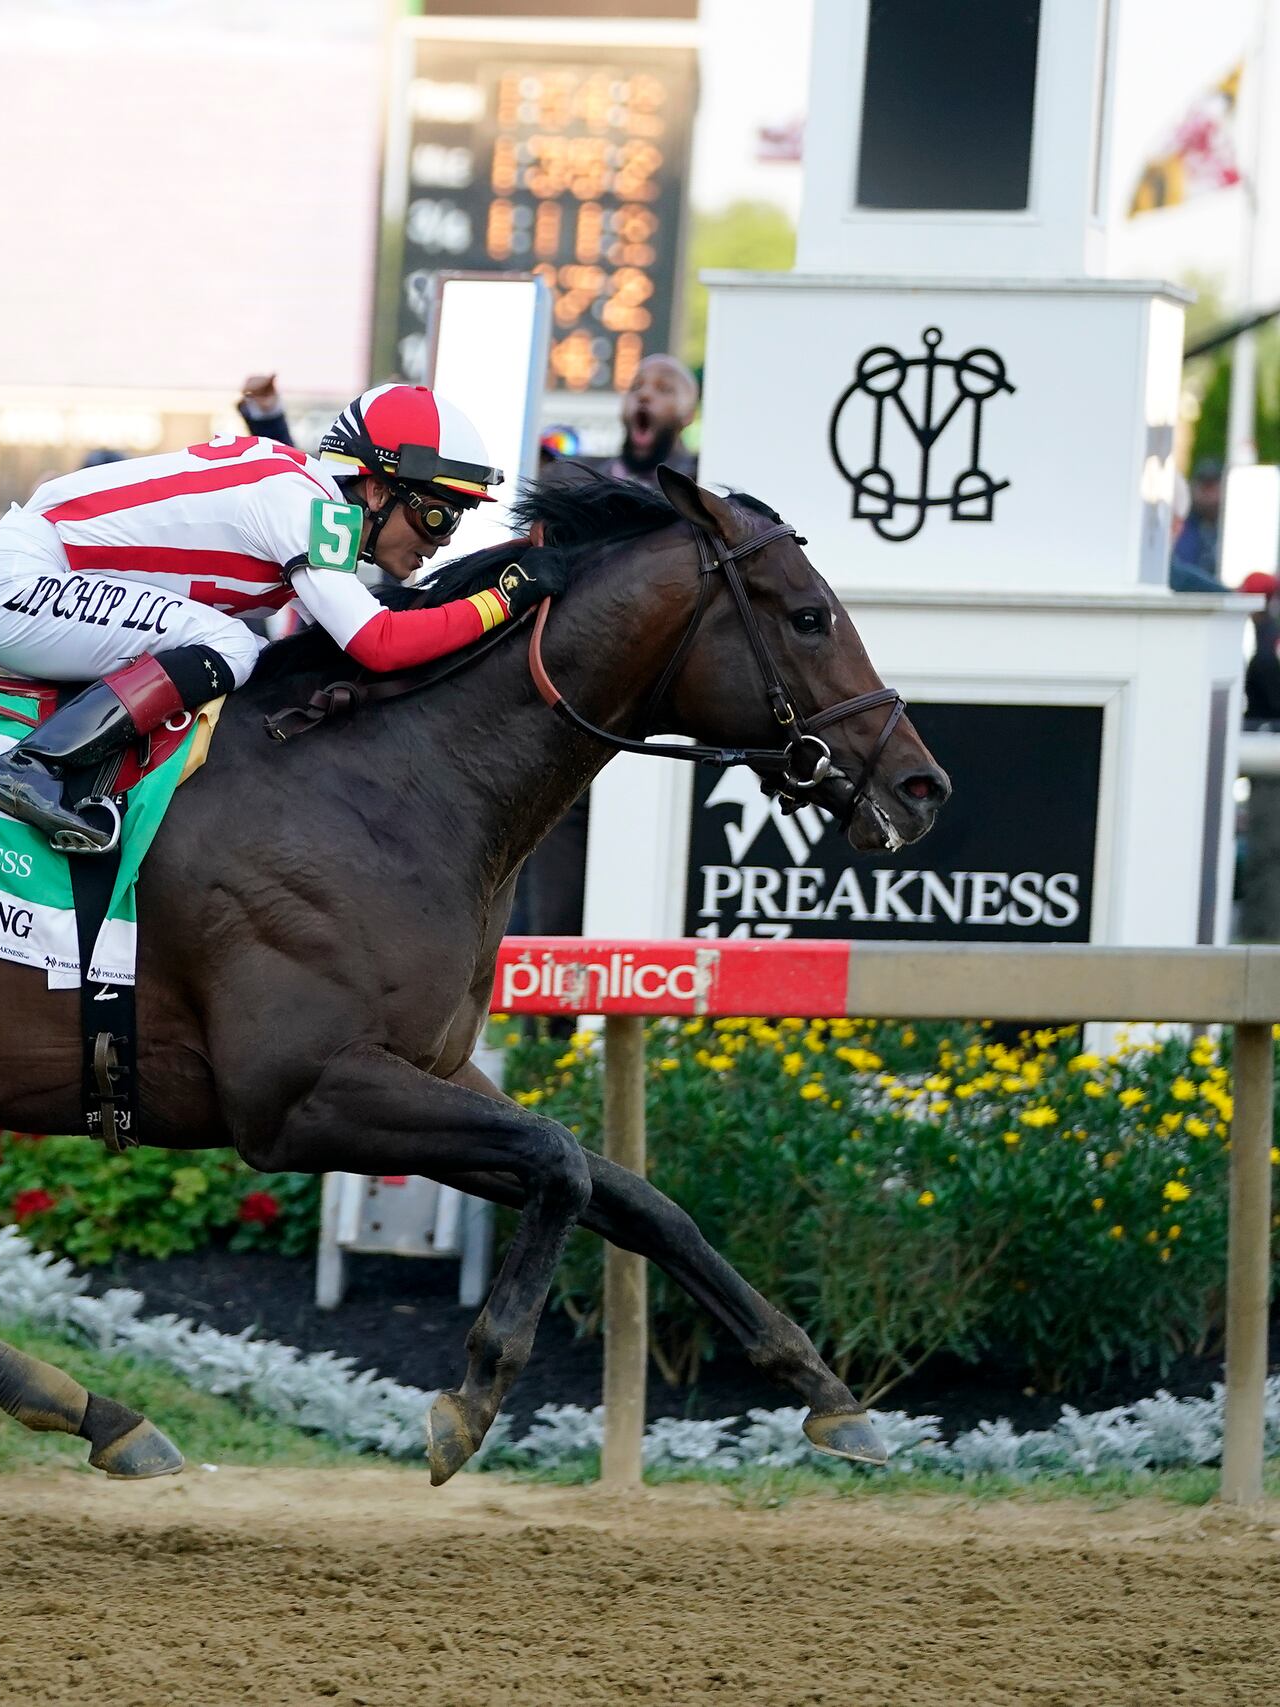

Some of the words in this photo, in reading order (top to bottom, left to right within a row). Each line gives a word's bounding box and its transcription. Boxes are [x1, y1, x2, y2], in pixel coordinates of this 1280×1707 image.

[319, 503, 352, 565] 5
[121, 591, 183, 634] LLC
[698, 865, 1080, 927] PREAKNESS
[102, 970, 136, 980] PREAKNES
[502, 953, 699, 1008] pimlico
